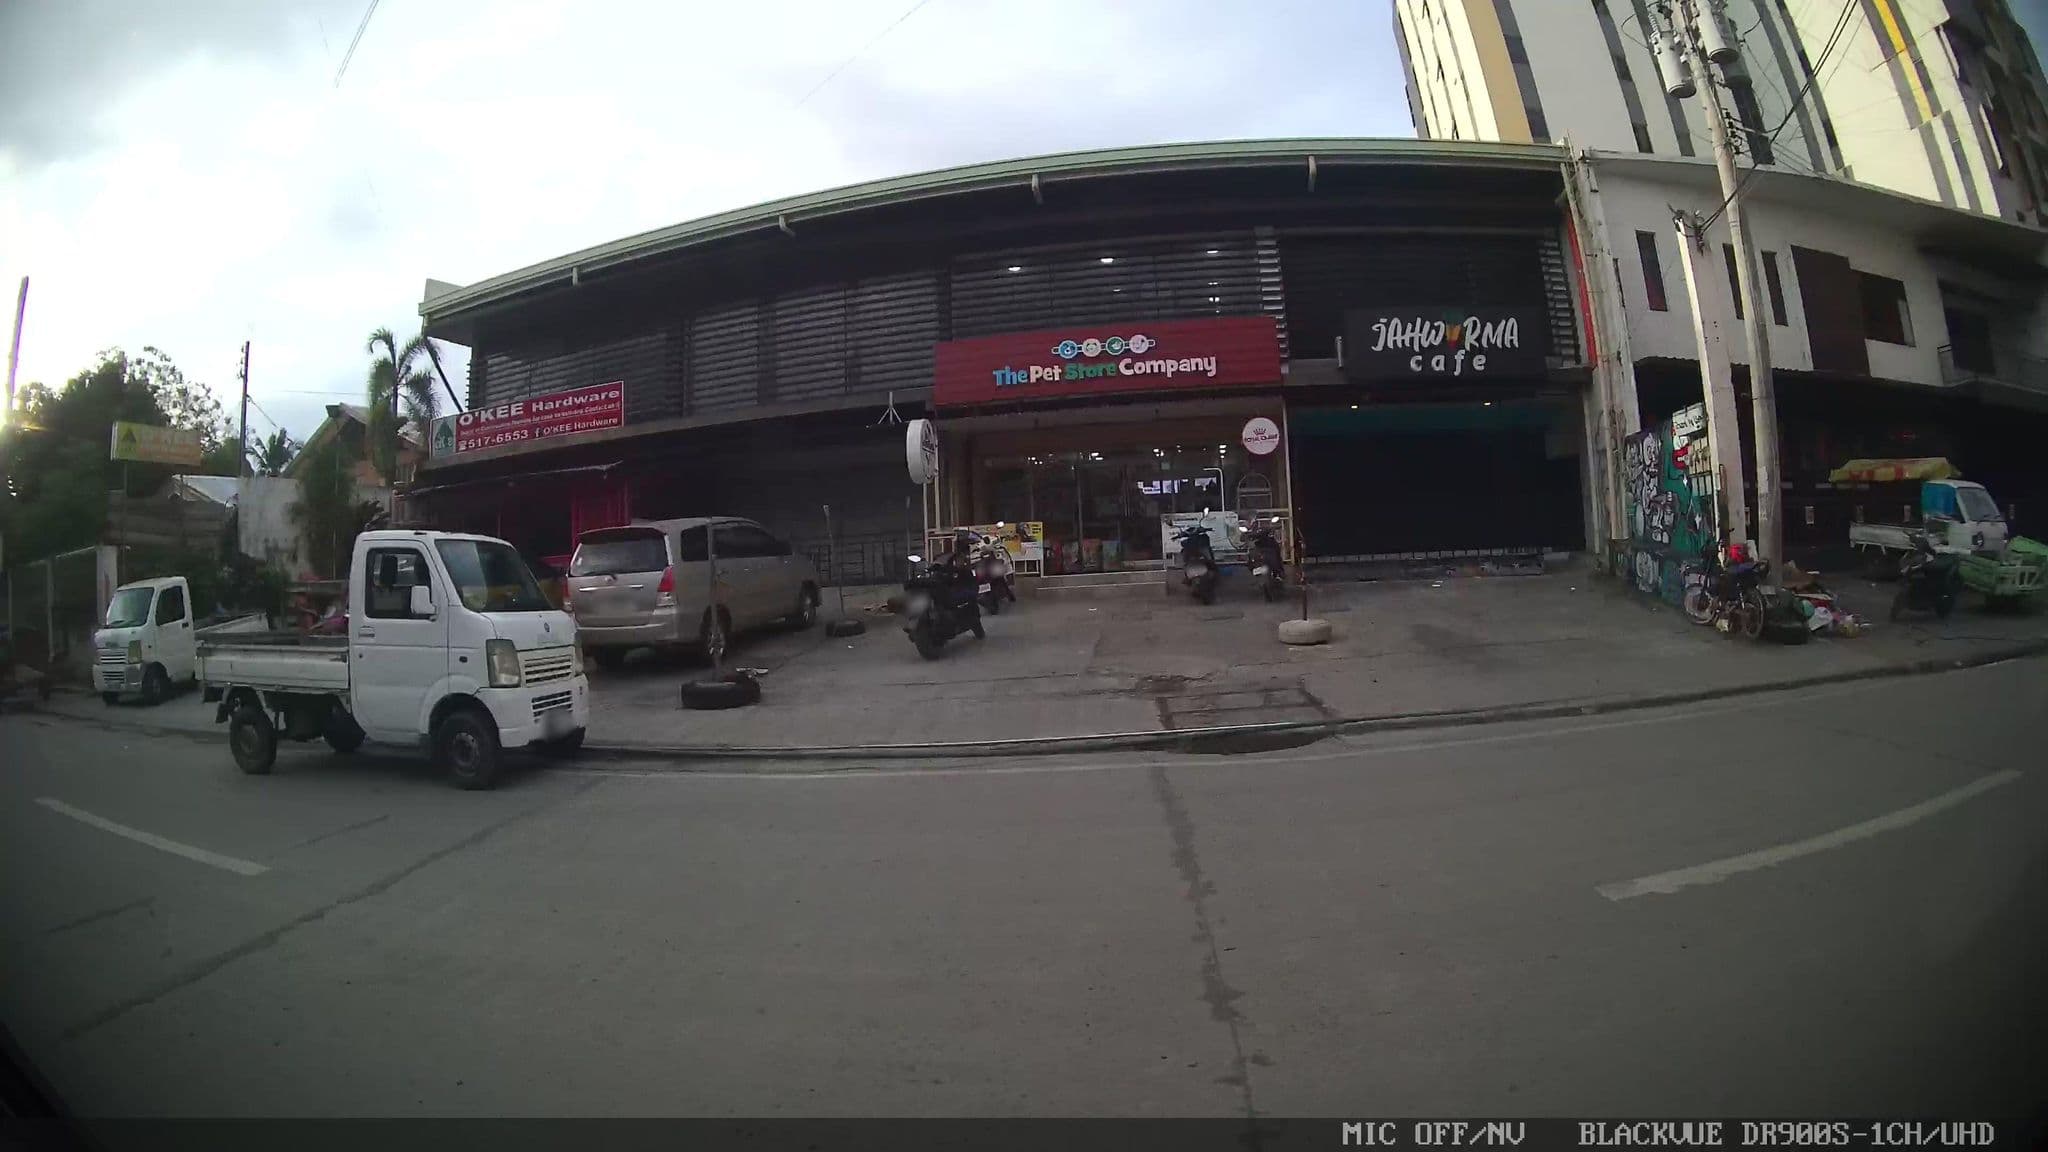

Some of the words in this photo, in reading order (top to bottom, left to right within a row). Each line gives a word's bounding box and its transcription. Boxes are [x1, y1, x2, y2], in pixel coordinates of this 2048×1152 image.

[993, 366, 1028, 386] The
[1029, 364, 1062, 383] Pet
[1065, 361, 1117, 380] Store
[1118, 354, 1217, 377] Company
[1410, 349, 1487, 376] cafe
[459, 402, 524, 426] O'KEE
[531, 389, 620, 413] Hardware
[469, 429, 529, 449] 517-6553
[543, 423, 572, 436] O'KEE
[574, 416, 619, 431] Hardware
